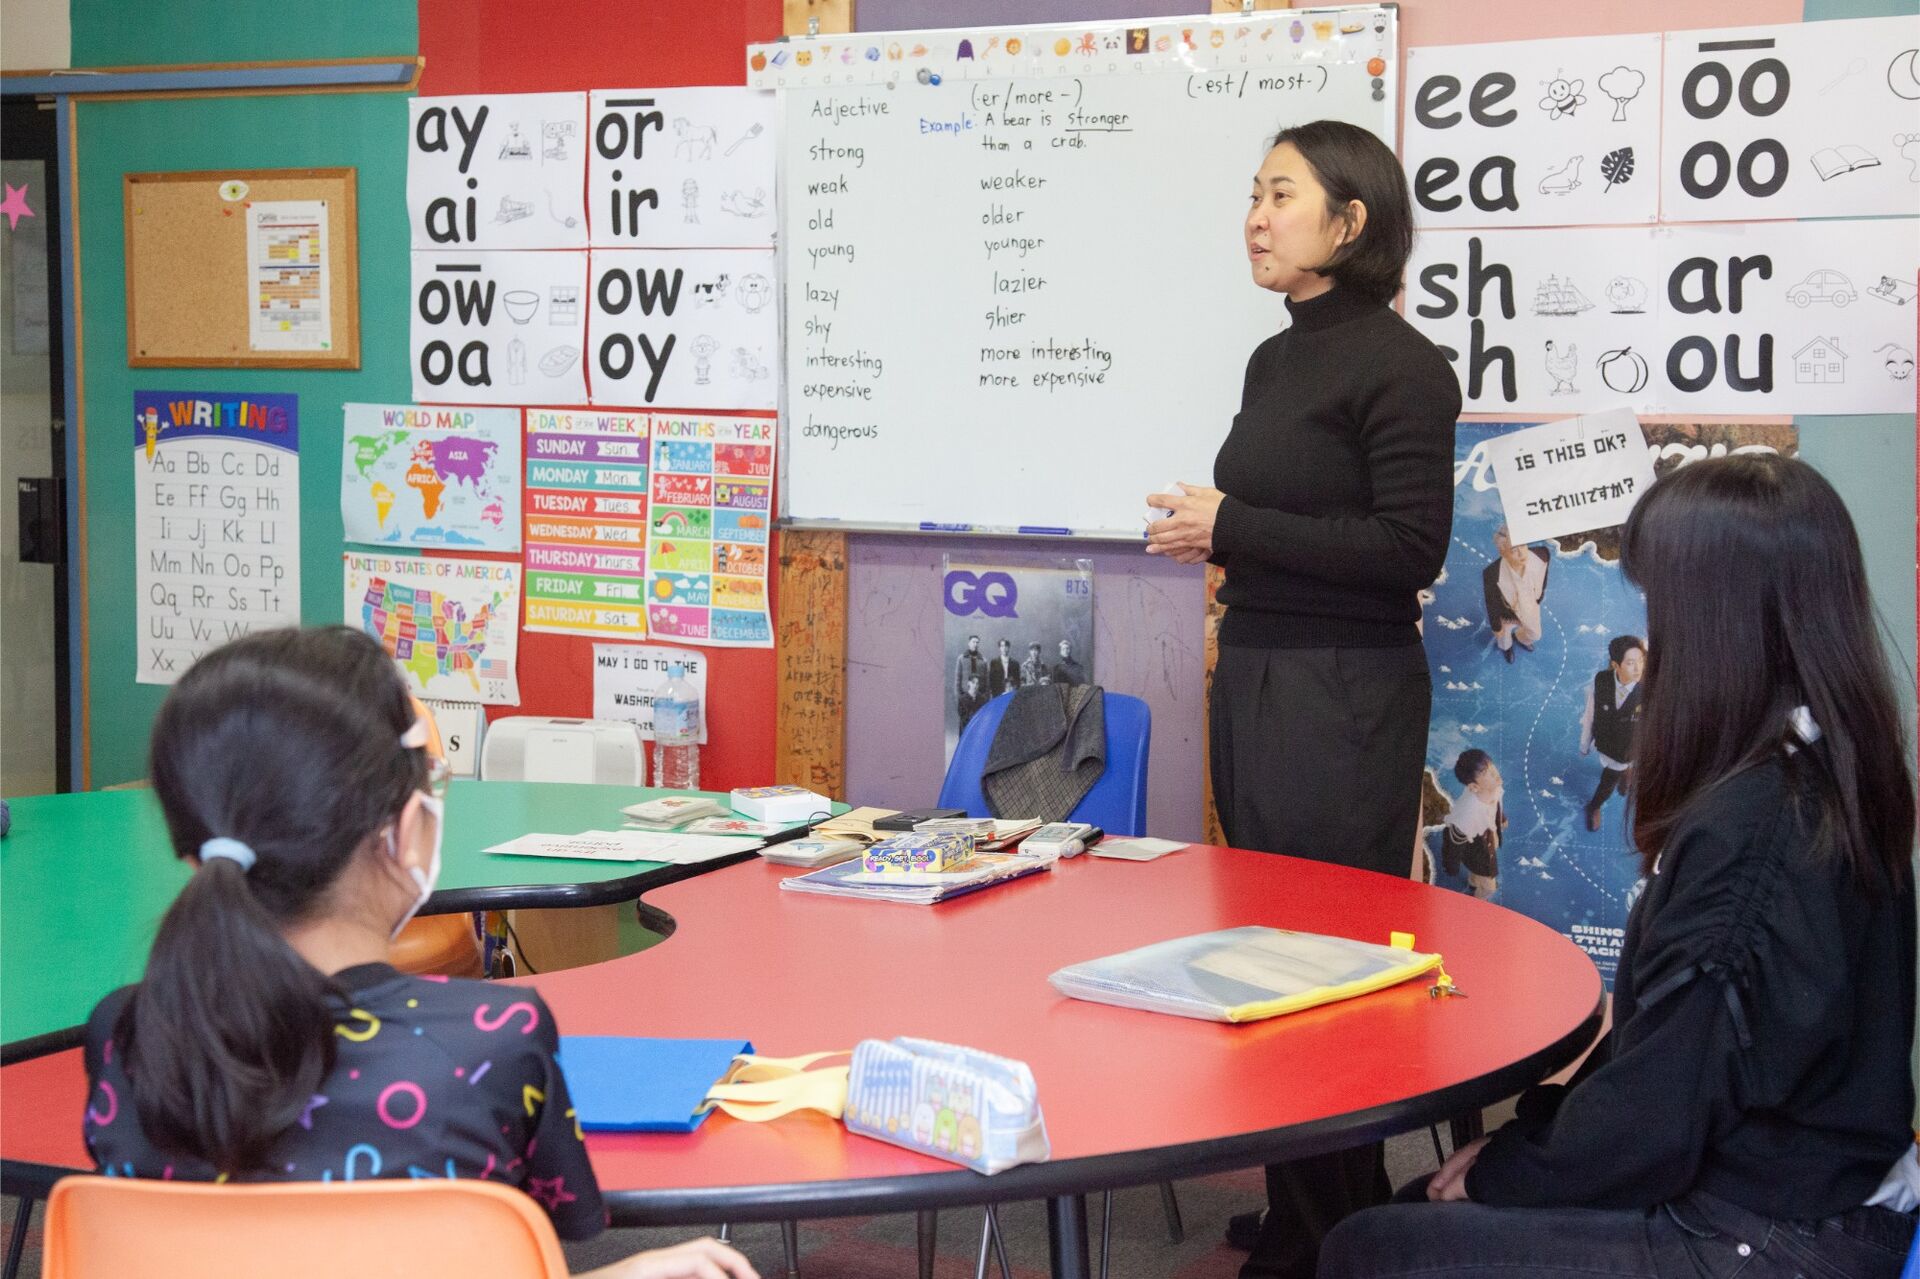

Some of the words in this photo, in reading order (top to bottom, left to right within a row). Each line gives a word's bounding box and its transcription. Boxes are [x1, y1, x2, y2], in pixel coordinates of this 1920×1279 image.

[1415, 71, 1518, 129] ee
[811, 97, 889, 126] Adjective
[985, 112, 995, 127] A
[1003, 111, 1032, 127] bear
[1041, 110, 1052, 126] is
[1068, 107, 1130, 129] stronger
[416, 105, 489, 174] ay
[981, 135, 1010, 152] than
[1024, 139, 1032, 150] a
[1052, 133, 1087, 150] crab.
[809, 137, 864, 168] strong
[981, 168, 1047, 190] weaker
[1680, 138, 1790, 200] oo
[808, 173, 848, 195] weak
[1414, 155, 1519, 212] ea
[425, 177, 478, 243] ai
[611, 170, 658, 237] ir
[982, 203, 1024, 225] older
[808, 208, 834, 230] old
[808, 244, 855, 270] young
[984, 238, 1045, 260] younger
[993, 268, 1047, 295] lazier
[1416, 237, 1516, 320] sh
[1667, 254, 1772, 315] ar
[598, 267, 683, 317] ow
[806, 282, 839, 311] lazy
[985, 305, 1026, 330] shier
[805, 314, 831, 344] shy
[420, 340, 492, 387] oa
[806, 347, 883, 378] interesting
[981, 347, 1021, 362] more
[1032, 337, 1112, 371] interesting
[1666, 333, 1774, 393] ou
[599, 333, 676, 403] oy
[803, 379, 872, 401] expensive
[979, 373, 1019, 387] more
[1033, 366, 1105, 393] expensive
[168, 399, 289, 433] WRITING
[383, 410, 431, 428] WORLD
[436, 412, 474, 429] MAP
[539, 414, 572, 430] DAYS
[597, 417, 635, 433] WEEK
[657, 420, 715, 437] MONTHS
[734, 424, 771, 440] YEAR
[802, 413, 878, 451] dangerous
[448, 451, 468, 461] ASIA
[536, 438, 586, 455] SUNDAY
[1514, 454, 1536, 471] IS
[1543, 443, 1587, 465] THIS
[1593, 433, 1627, 454] OK?
[152, 450, 175, 473] Aa
[187, 451, 210, 474] Bb
[221, 452, 244, 475] Cc
[255, 453, 279, 477] Dd
[748, 462, 770, 475] JULY
[407, 473, 438, 485] AFRICA
[533, 466, 590, 484] MONDAY
[155, 483, 175, 506] Ee
[189, 484, 209, 507] Ff
[219, 485, 246, 518] Gg
[256, 487, 279, 510] Hh
[533, 495, 588, 512] TUESDAY
[667, 491, 711, 505] FEBRUARY
[732, 496, 768, 507] AUGUST
[223, 520, 244, 543] Kk
[529, 523, 594, 539] WEDNESDAY
[676, 525, 710, 537] MARCH
[151, 551, 181, 574] Mm
[191, 552, 214, 575] Nn
[223, 553, 250, 577] Oo
[260, 555, 284, 587] Pp
[529, 549, 593, 568] THURSDAY
[726, 563, 764, 575] OCTOBER
[350, 558, 391, 572] UNITED
[395, 560, 432, 576] STATES
[436, 563, 451, 577] OF
[456, 565, 512, 582] AMERICA
[536, 577, 583, 595] FRIDAY
[944, 570, 1019, 618] GQ
[1066, 580, 1089, 595] BTS
[150, 583, 181, 616] Qq
[193, 585, 214, 608] Rr
[228, 587, 247, 611] Ss
[259, 589, 280, 612] Tt
[687, 592, 709, 604] MAY
[529, 605, 593, 625] SATURDAY
[151, 616, 174, 640] Uu
[190, 617, 212, 641] Vv
[680, 623, 707, 637] JUNE
[718, 627, 769, 640] DECEMBER
[151, 649, 175, 671] Xx
[598, 656, 618, 669] MAY
[634, 658, 648, 670] GO
[653, 660, 669, 672] TO
[449, 735, 461, 752] S
[1575, 935, 1607, 946] 7TH
[1610, 938, 1624, 948] A
